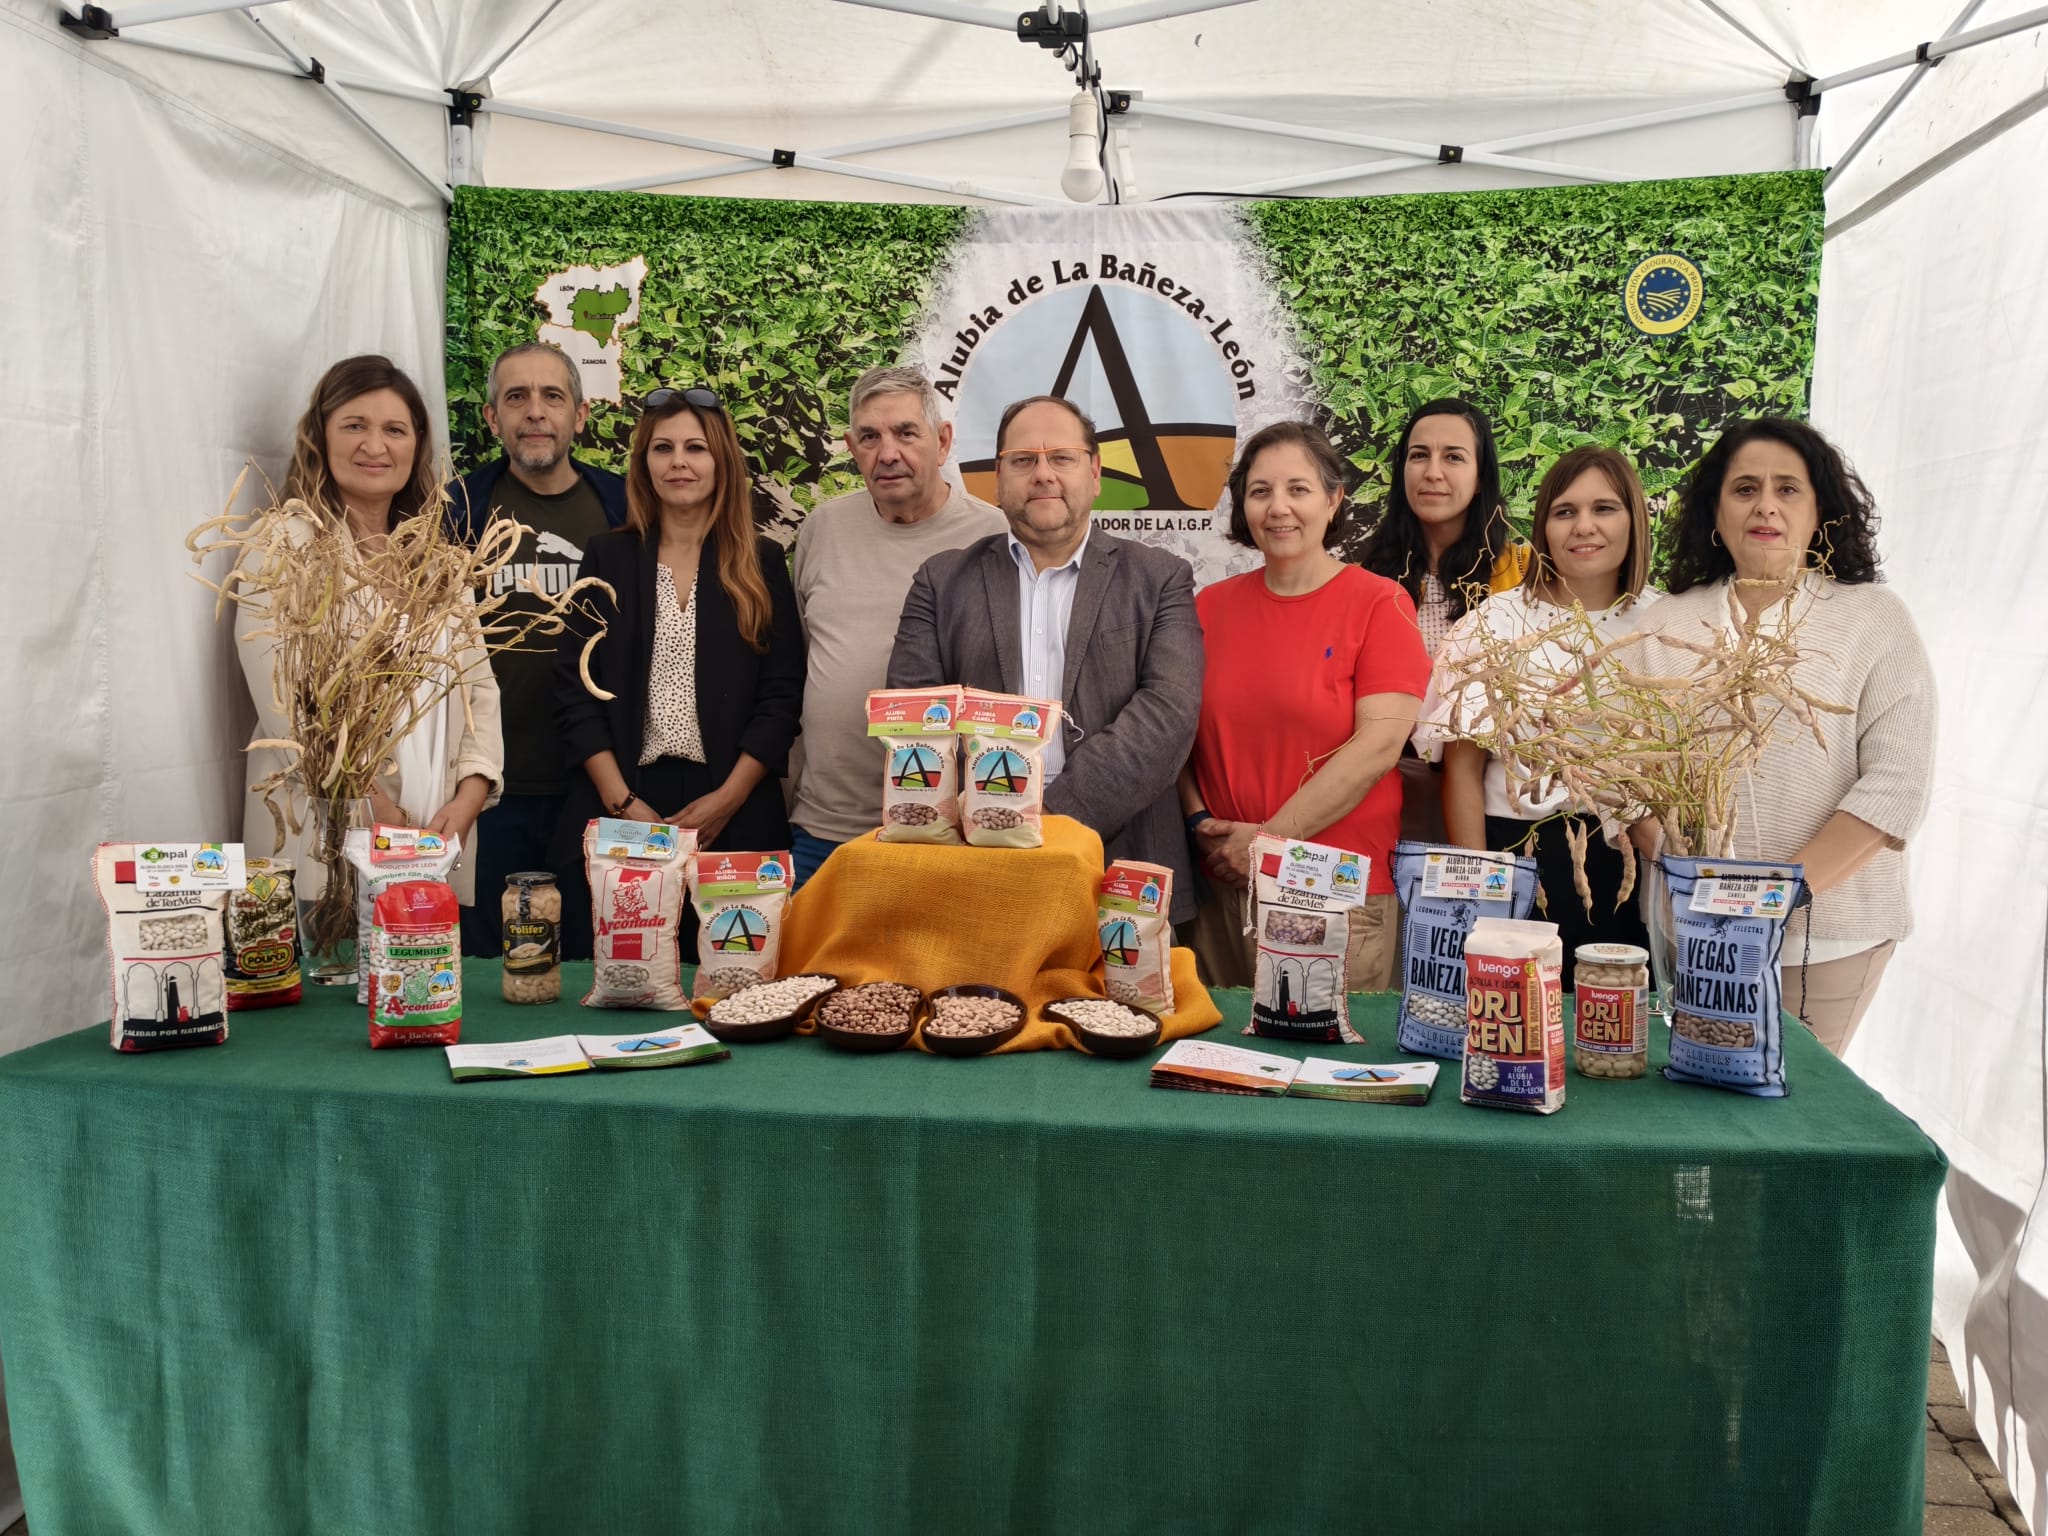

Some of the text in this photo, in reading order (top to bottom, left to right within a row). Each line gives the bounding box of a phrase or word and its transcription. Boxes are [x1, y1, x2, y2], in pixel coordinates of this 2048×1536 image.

[934, 254, 1257, 402] Alubia de La Bañeza-León
[1134, 518, 1153, 531] DE
[1156, 518, 1175, 531] LA
[1178, 518, 1213, 531] I.G.P.
[509, 924, 545, 934] Polifer
[597, 914, 667, 936] Arconada
[390, 946, 448, 957] LEGUMBRES
[1430, 926, 1467, 957] VEGA
[1686, 936, 1738, 975] VEGAS
[1411, 956, 1467, 997] BAÑEZA
[1478, 959, 1520, 978] luengo
[1591, 990, 1619, 1002] luengo
[1676, 967, 1758, 1014] BAÑEZANAS
[384, 996, 450, 1018] Arconada
[1470, 988, 1522, 1023] ORI
[1582, 1000, 1620, 1023] ORI
[1469, 1019, 1524, 1055] GEN
[1581, 1019, 1620, 1041] GEN
[1510, 1079, 1520, 1087] DE
